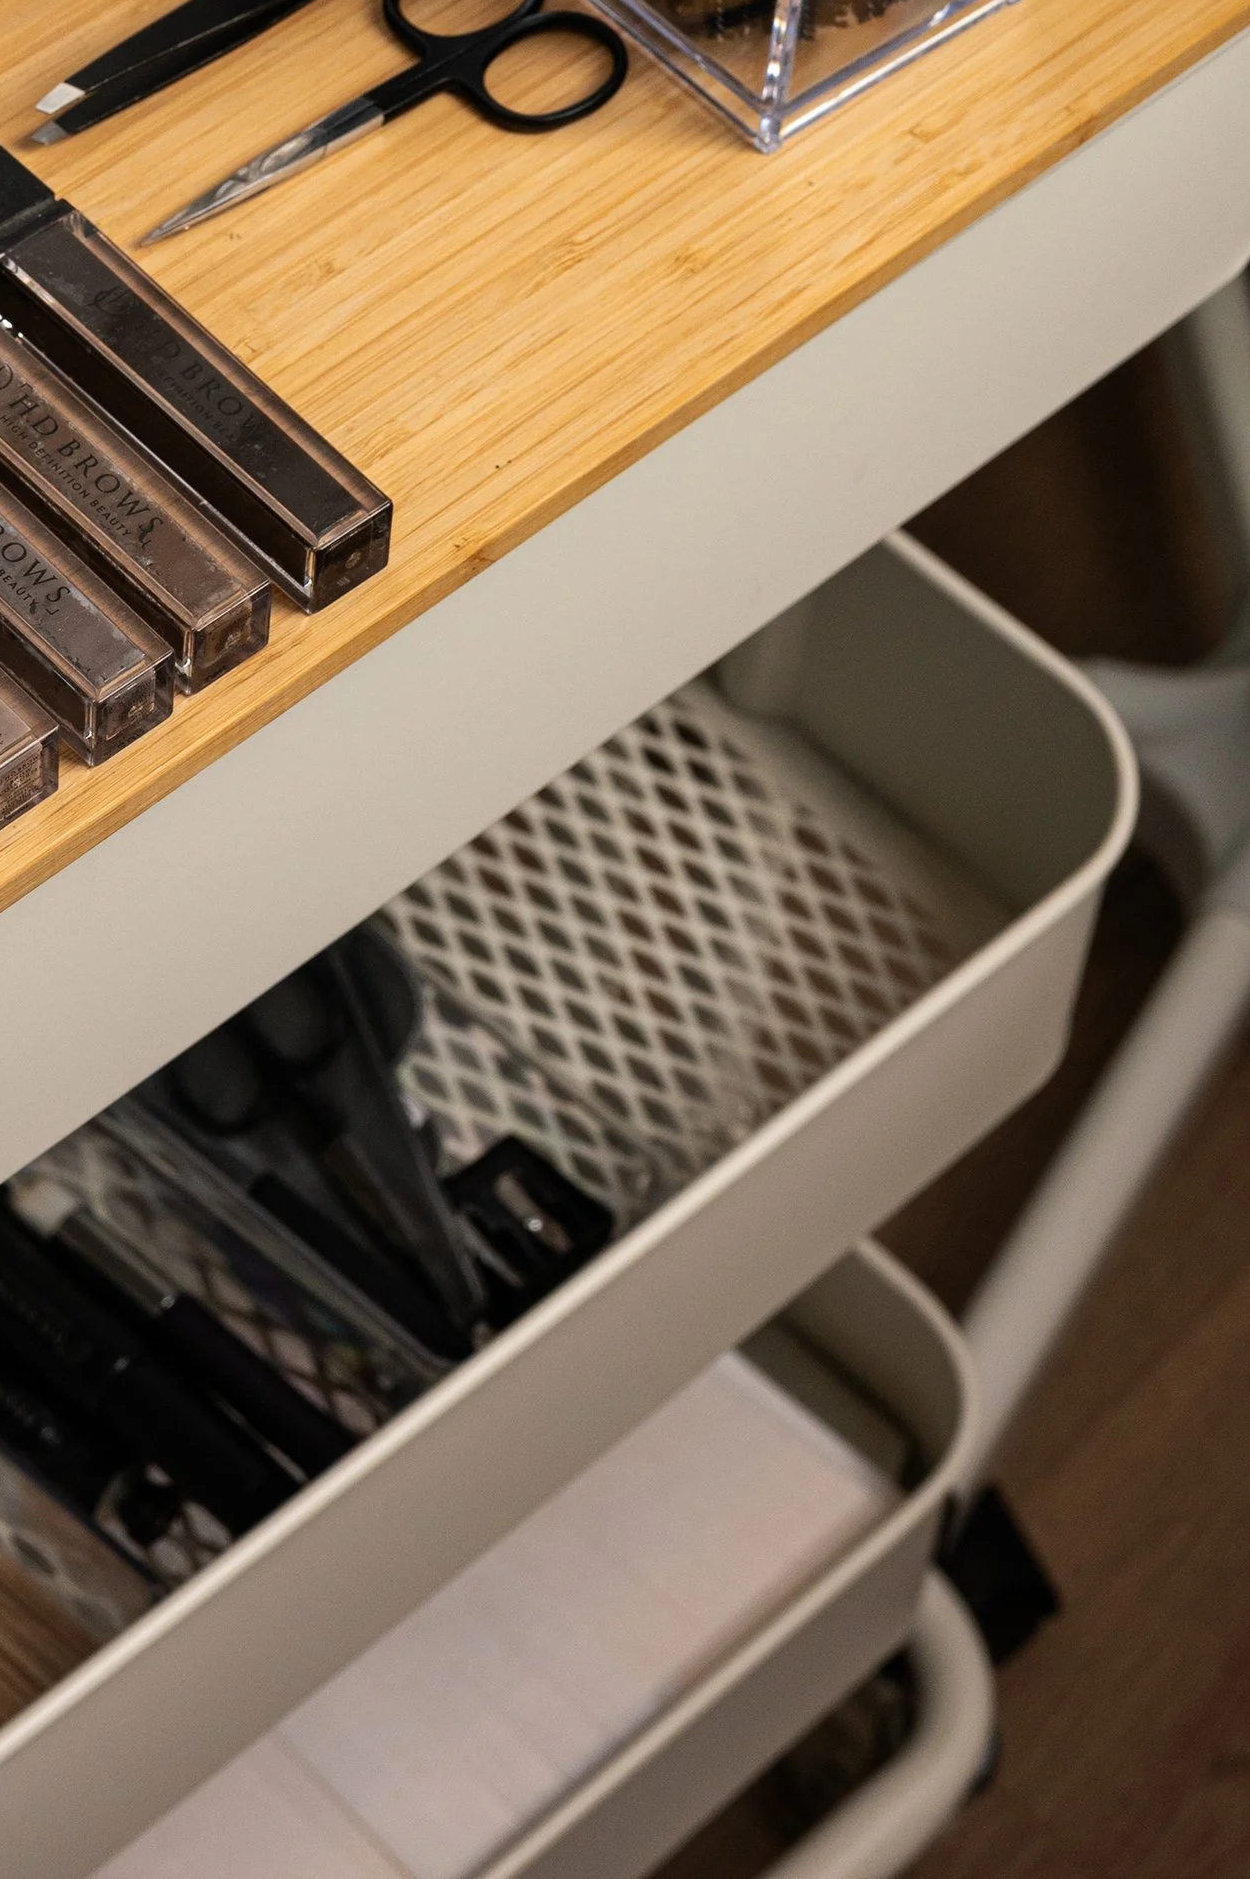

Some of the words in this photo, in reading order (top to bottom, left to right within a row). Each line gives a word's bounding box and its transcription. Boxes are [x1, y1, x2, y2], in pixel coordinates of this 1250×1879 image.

[0, 414, 27, 441] HIGH
[28, 442, 91, 499] DEFINITION
[91, 499, 131, 538] BEAUTY
[9, 393, 59, 437] HD
[57, 438, 164, 533] BROWS
